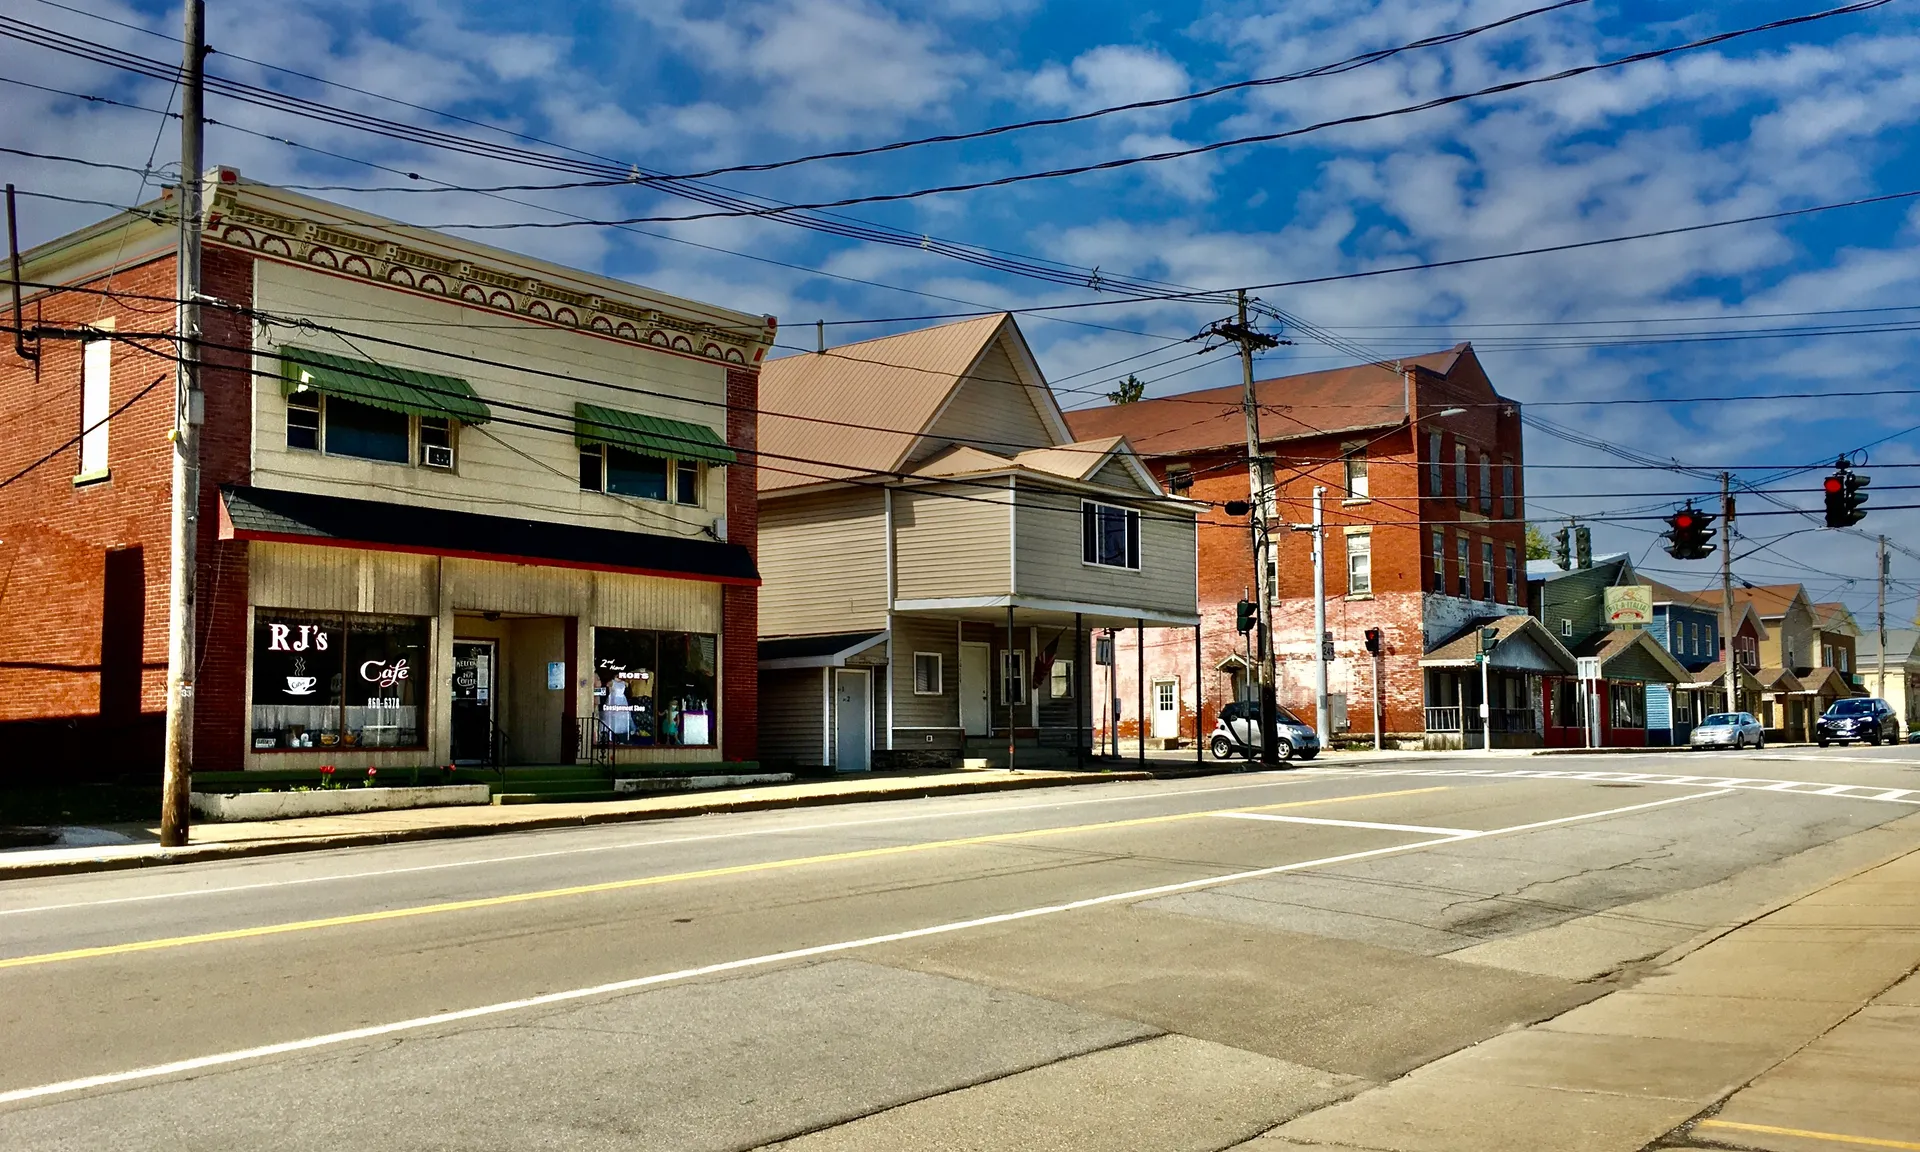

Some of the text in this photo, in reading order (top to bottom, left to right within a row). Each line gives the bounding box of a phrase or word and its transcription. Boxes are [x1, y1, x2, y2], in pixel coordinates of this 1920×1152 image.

[268, 623, 328, 652] RJ's
[600, 659, 615, 668] 2nd
[360, 659, 410, 688] Cafe
[602, 704, 646, 712] Consignment Shop
